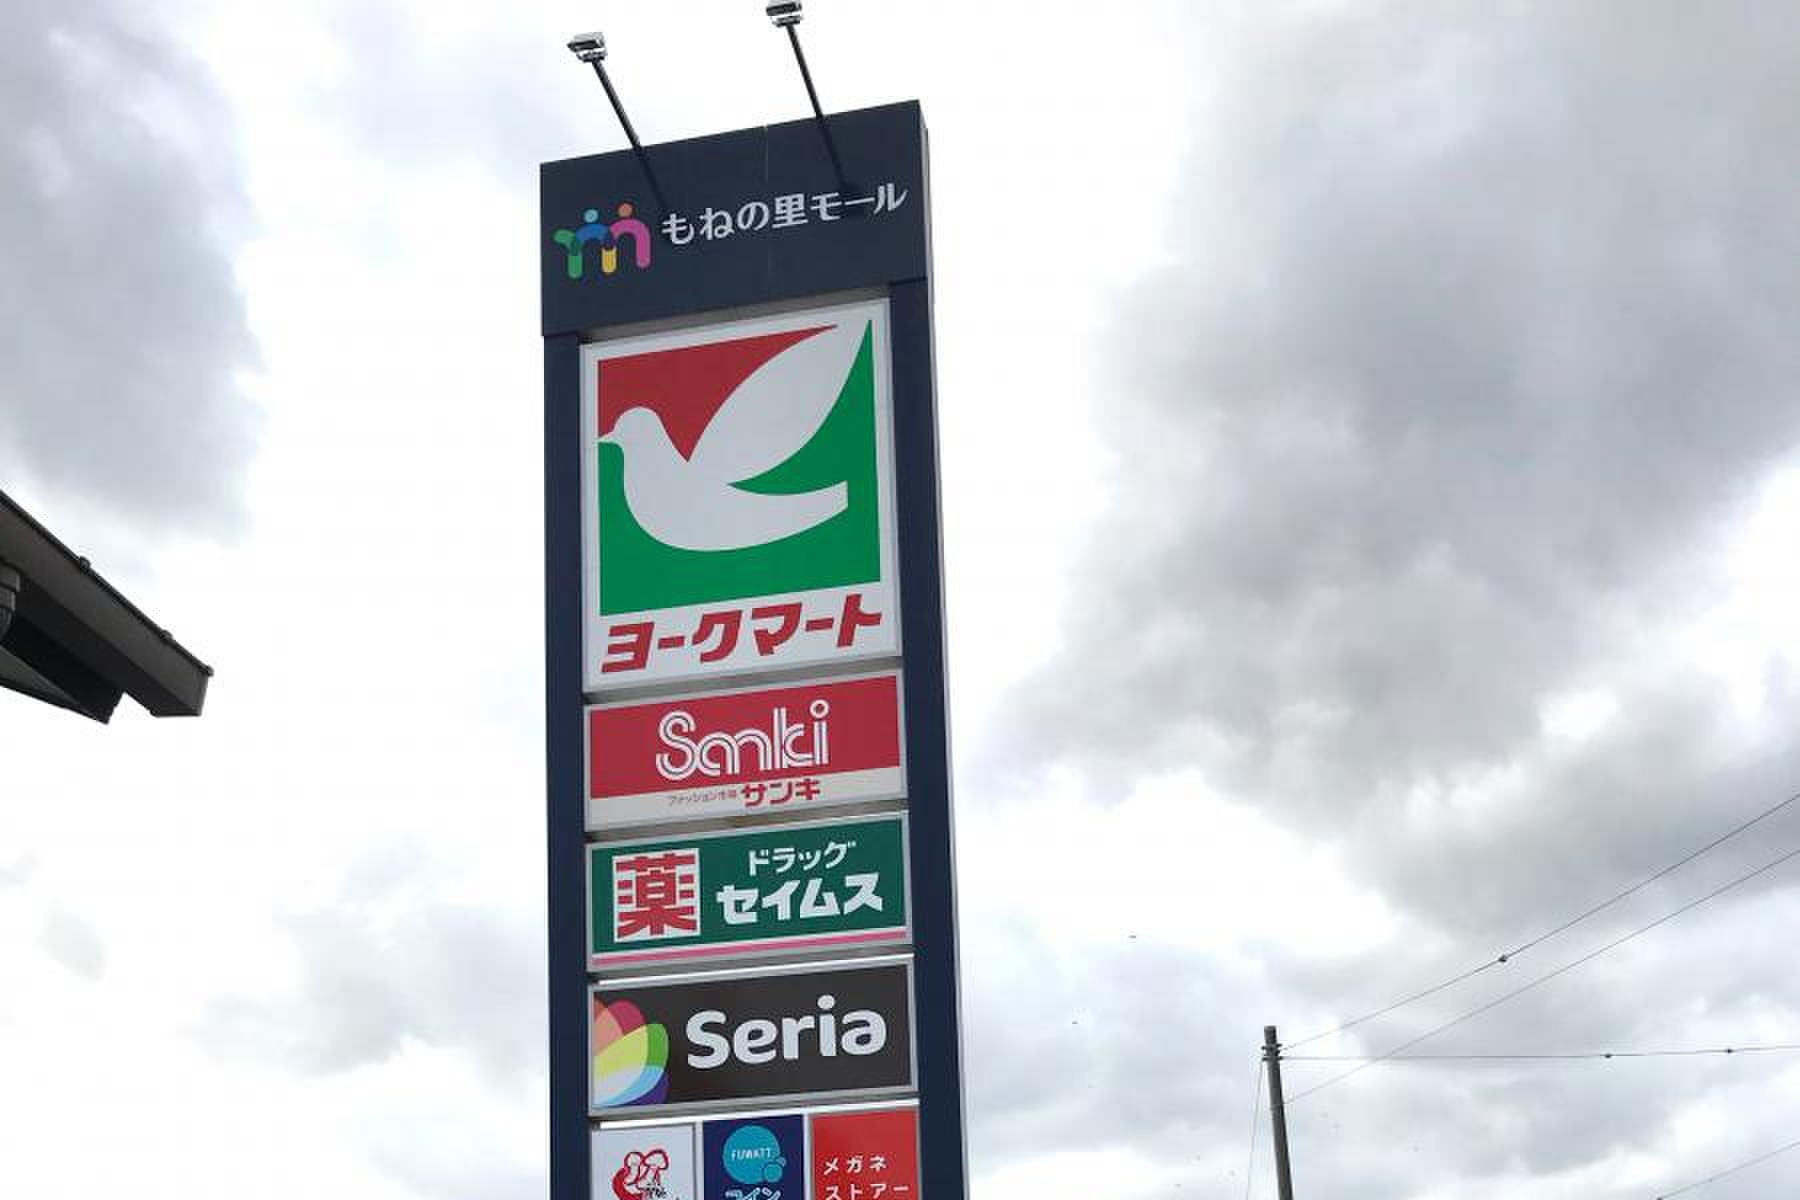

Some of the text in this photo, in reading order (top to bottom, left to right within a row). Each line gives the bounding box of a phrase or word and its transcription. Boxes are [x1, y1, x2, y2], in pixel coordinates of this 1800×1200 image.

[662, 183, 908, 245] もねの里モール
[601, 593, 882, 673] ヨークマート
[655, 699, 830, 781] Sanki
[741, 778, 821, 807] サンキ
[749, 841, 857, 876] ドラッグ
[615, 852, 698, 939] 薬
[715, 872, 883, 926] セイムス
[686, 994, 887, 1069] Seria
[823, 1155, 888, 1176] メガネ
